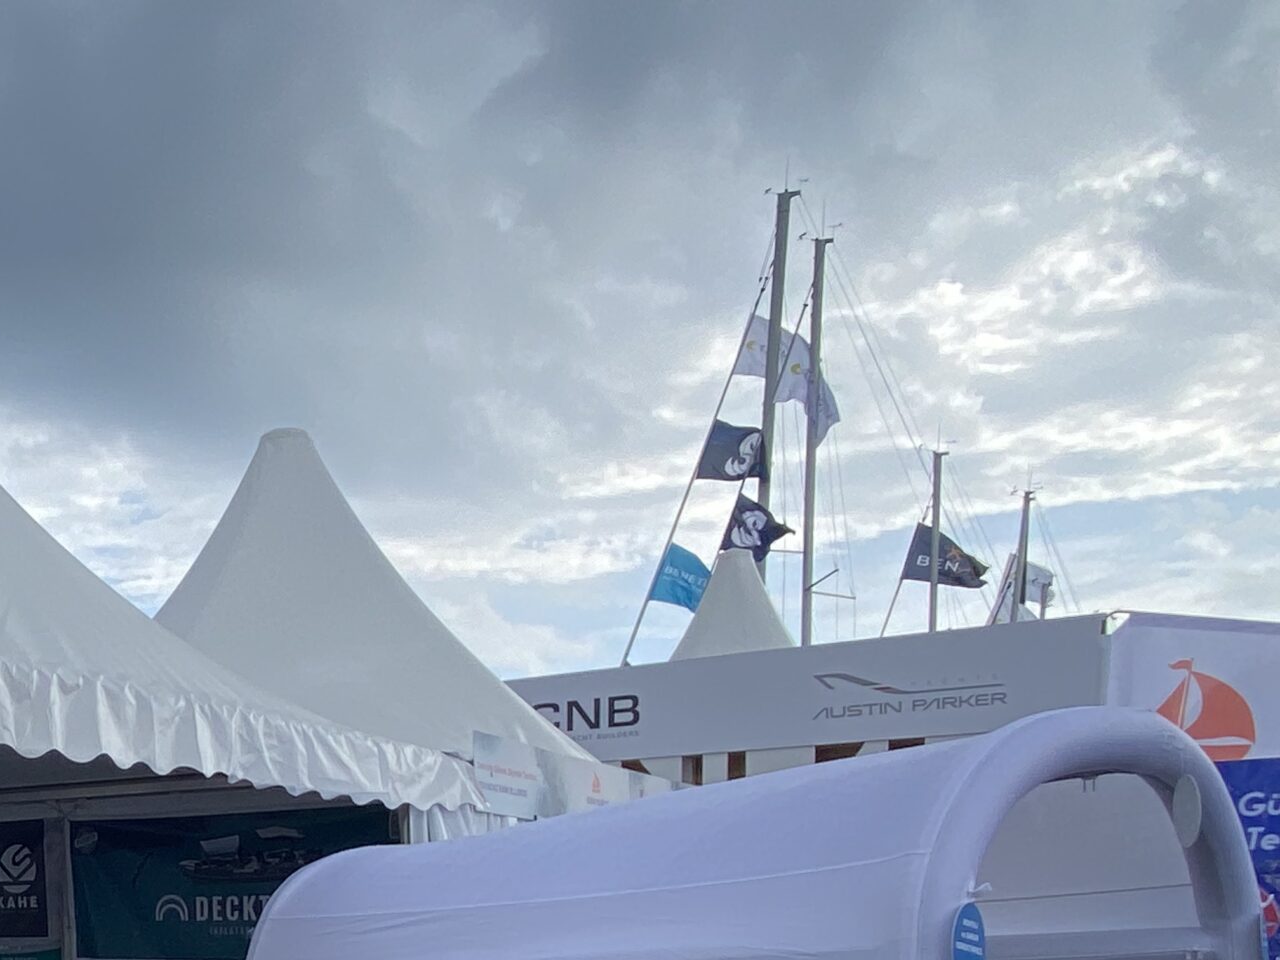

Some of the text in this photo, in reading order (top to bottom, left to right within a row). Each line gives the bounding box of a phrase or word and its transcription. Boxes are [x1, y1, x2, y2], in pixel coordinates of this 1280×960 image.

[664, 565, 707, 586] BENET
[812, 692, 1008, 721] AUSTIN PARKER
[1247, 827, 1280, 850] Te
[196, 895, 269, 922] DECKT
